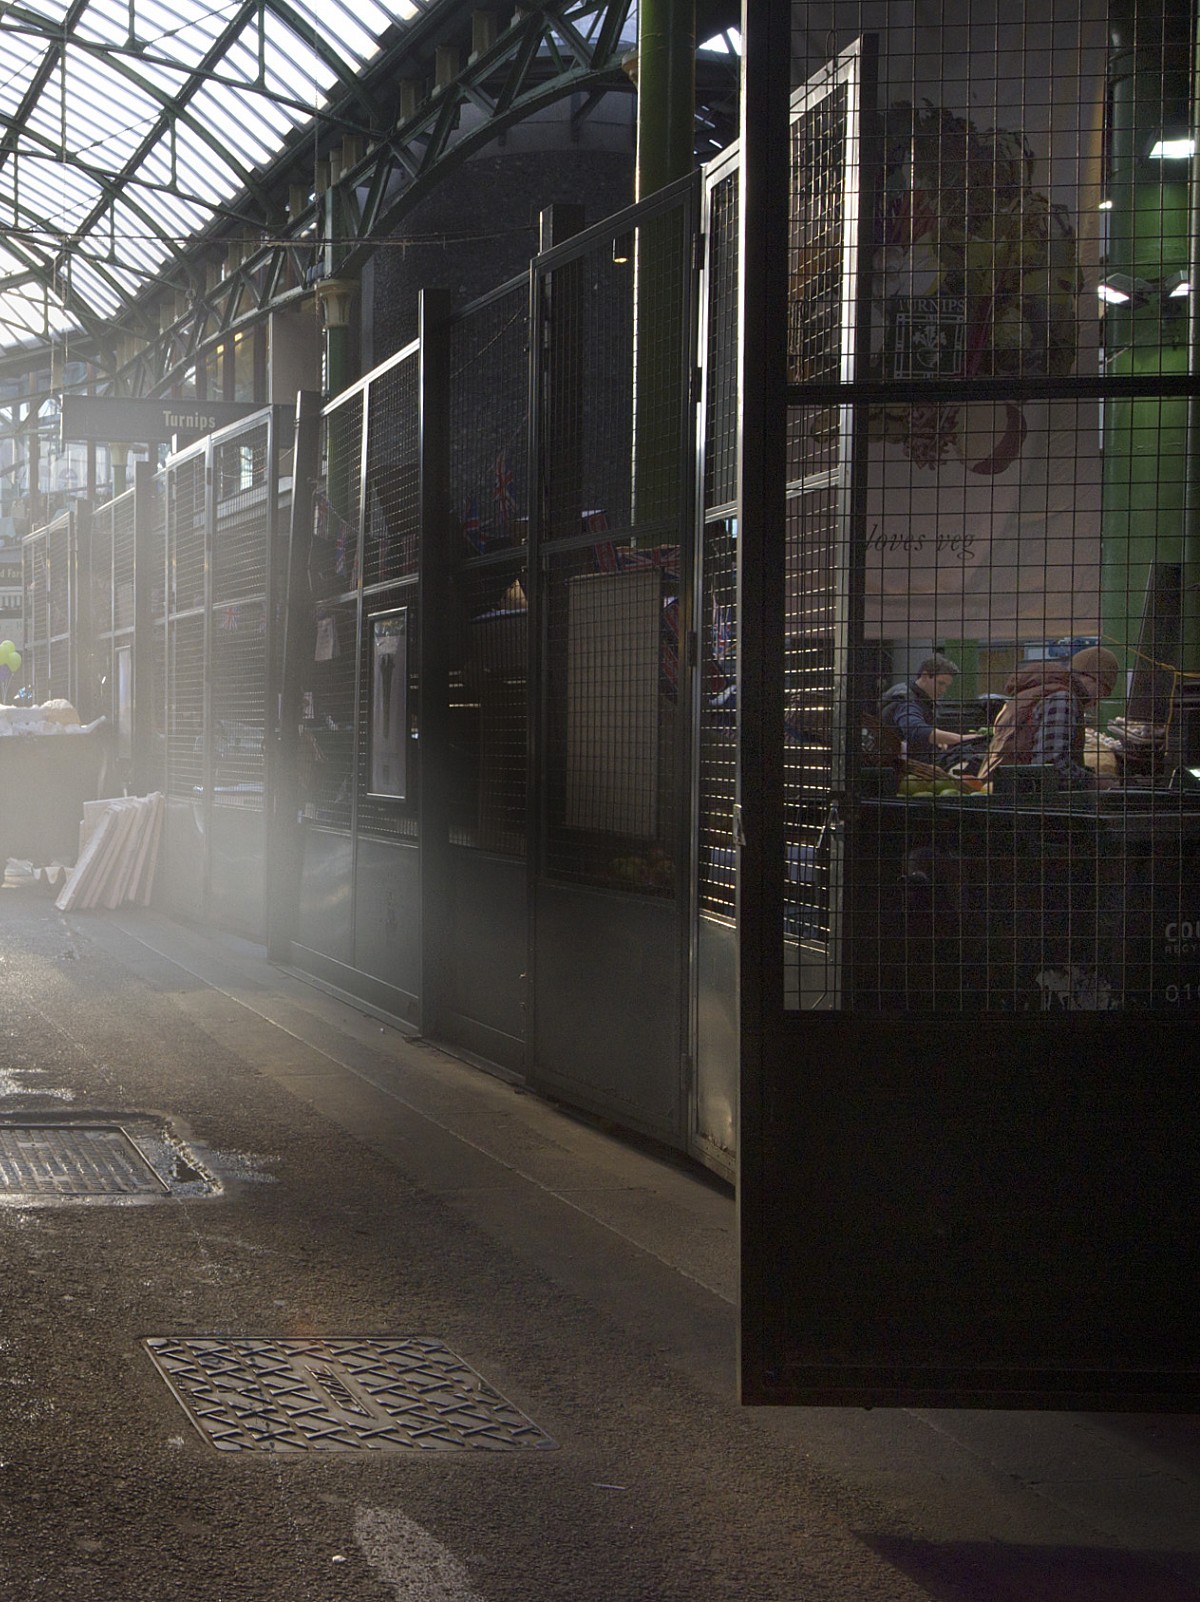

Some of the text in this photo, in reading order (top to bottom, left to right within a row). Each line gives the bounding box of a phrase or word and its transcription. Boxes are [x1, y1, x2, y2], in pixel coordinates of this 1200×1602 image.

[898, 298, 965, 313] TURNIPS
[163, 410, 216, 431] Turnips
[866, 523, 976, 560] loves veg
[7, 567, 22, 578] Far
[1165, 983, 1200, 1002] 01
